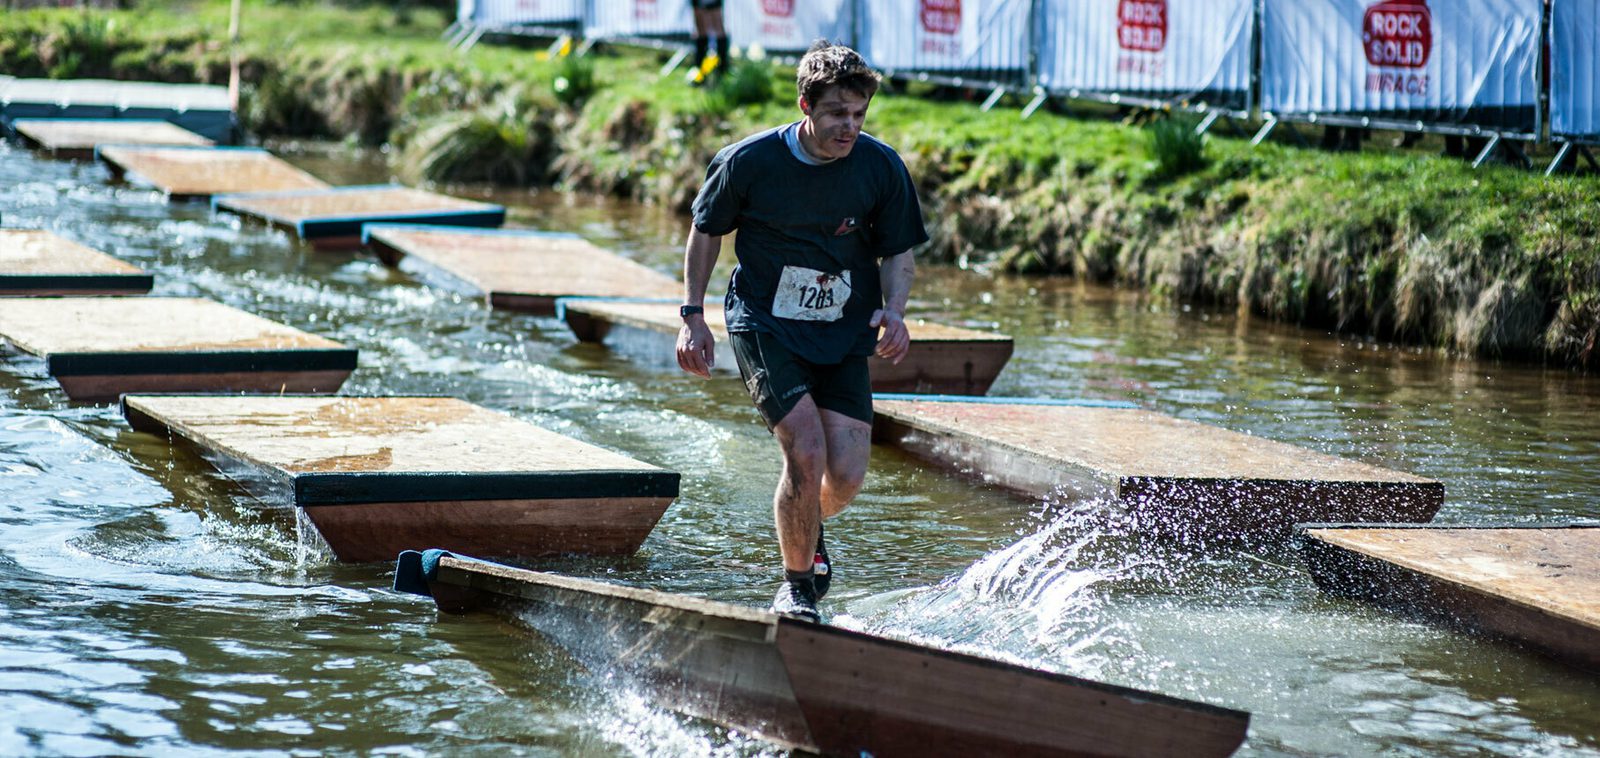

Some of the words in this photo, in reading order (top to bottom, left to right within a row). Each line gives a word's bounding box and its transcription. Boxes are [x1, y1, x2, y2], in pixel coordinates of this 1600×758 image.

[1123, 1, 1163, 24] ROCK
[1371, 12, 1423, 37] ROCK
[1122, 26, 1163, 49] SOLID
[1371, 40, 1424, 64] SOLID
[798, 286, 834, 309] 1283
